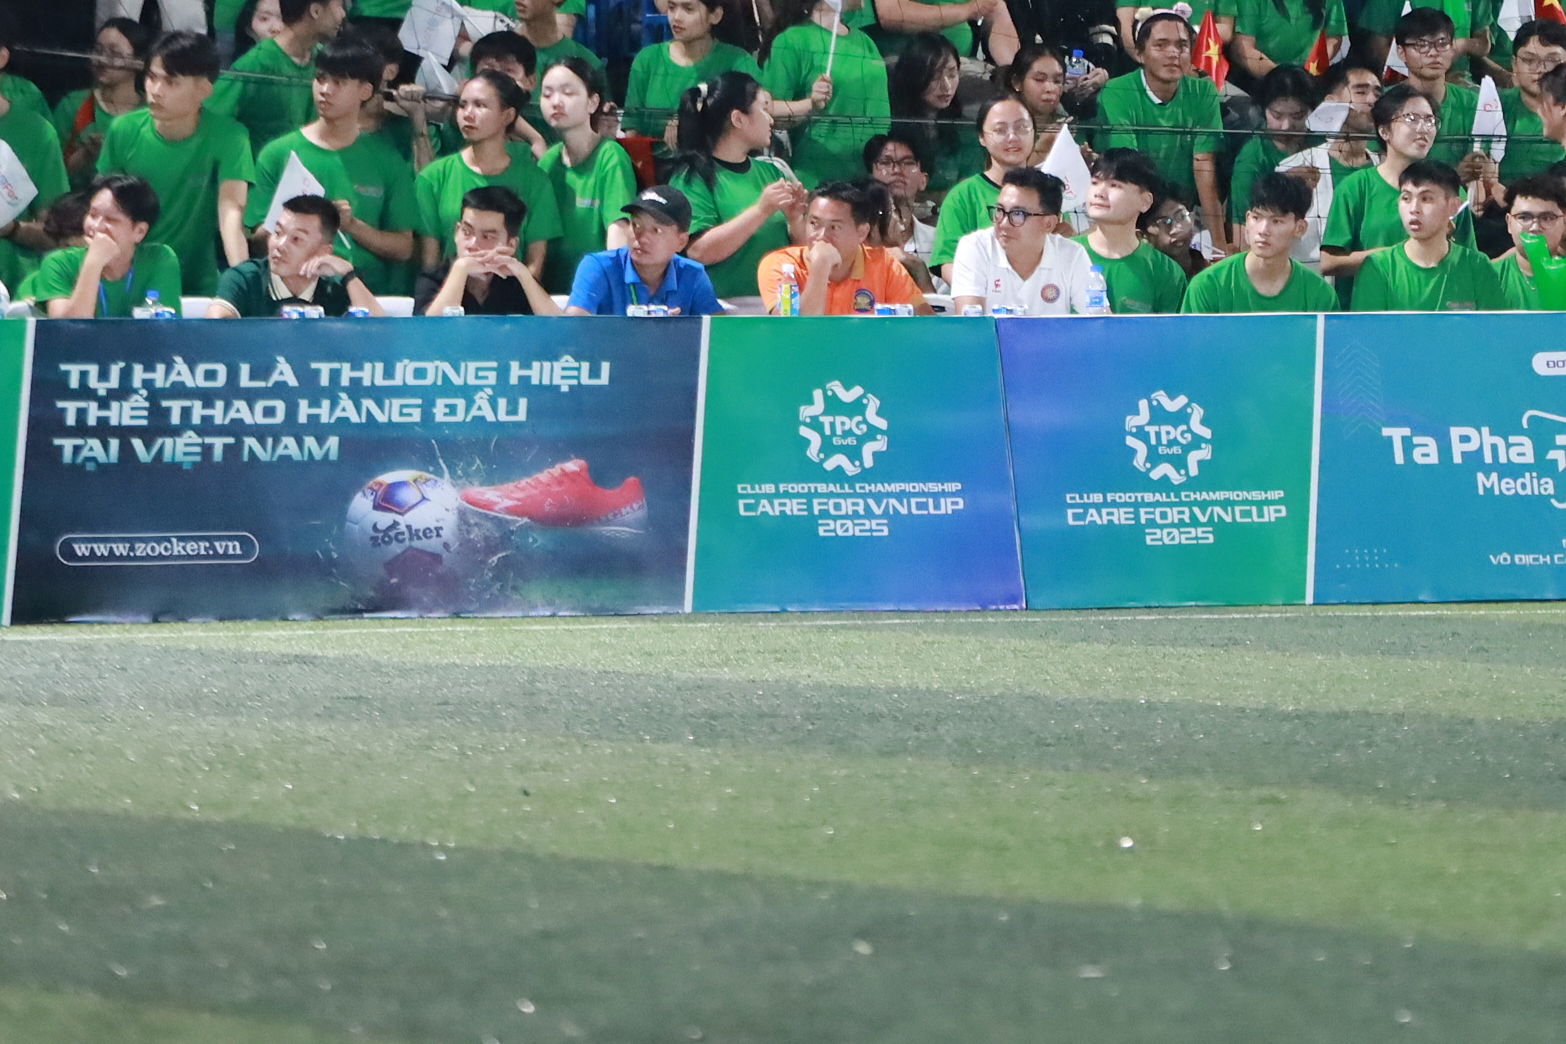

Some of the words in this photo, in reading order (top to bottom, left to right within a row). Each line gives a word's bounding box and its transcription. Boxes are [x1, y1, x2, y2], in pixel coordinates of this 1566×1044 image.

[59, 361, 125, 396] TỰ
[132, 356, 227, 388] HÀO
[239, 356, 299, 388] LÀ
[311, 358, 498, 387] THƯƠNG
[509, 355, 611, 392] HIỆU
[56, 388, 150, 426] THỂ
[160, 399, 286, 425] THAO
[298, 392, 422, 424] HÀNG
[432, 388, 528, 423] ĐẦU
[818, 415, 868, 436] TPG
[1144, 425, 1192, 445] TPG
[52, 437, 120, 471] TẠI
[129, 429, 235, 470] VIỆT
[243, 435, 339, 462] NAM
[1381, 427, 1440, 465] Ta
[1449, 426, 1535, 464] Pha
[737, 483, 776, 494] CLUB
[779, 483, 854, 494] FOOTBALL
[855, 482, 962, 493] CHAMPIONSHIP
[1476, 472, 1555, 496] Media
[738, 498, 808, 516] CARE
[812, 498, 865, 515] FOR
[866, 497, 908, 515] VN
[909, 497, 965, 515] CUP
[1066, 493, 1104, 504] CLUB
[1107, 492, 1180, 503] FOOTBALL
[1181, 490, 1285, 501] CHAMPIONSHIP
[1067, 508, 1136, 526] CARE
[1139, 507, 1190, 524] FOR
[1191, 506, 1233, 523] VN
[1234, 505, 1288, 522] CUP
[369, 523, 444, 548] zocker
[818, 519, 889, 537] 2025
[1145, 527, 1215, 546] 2025
[72, 537, 243, 557] www.zocker.vn
[1489, 552, 1511, 565] VÔ
